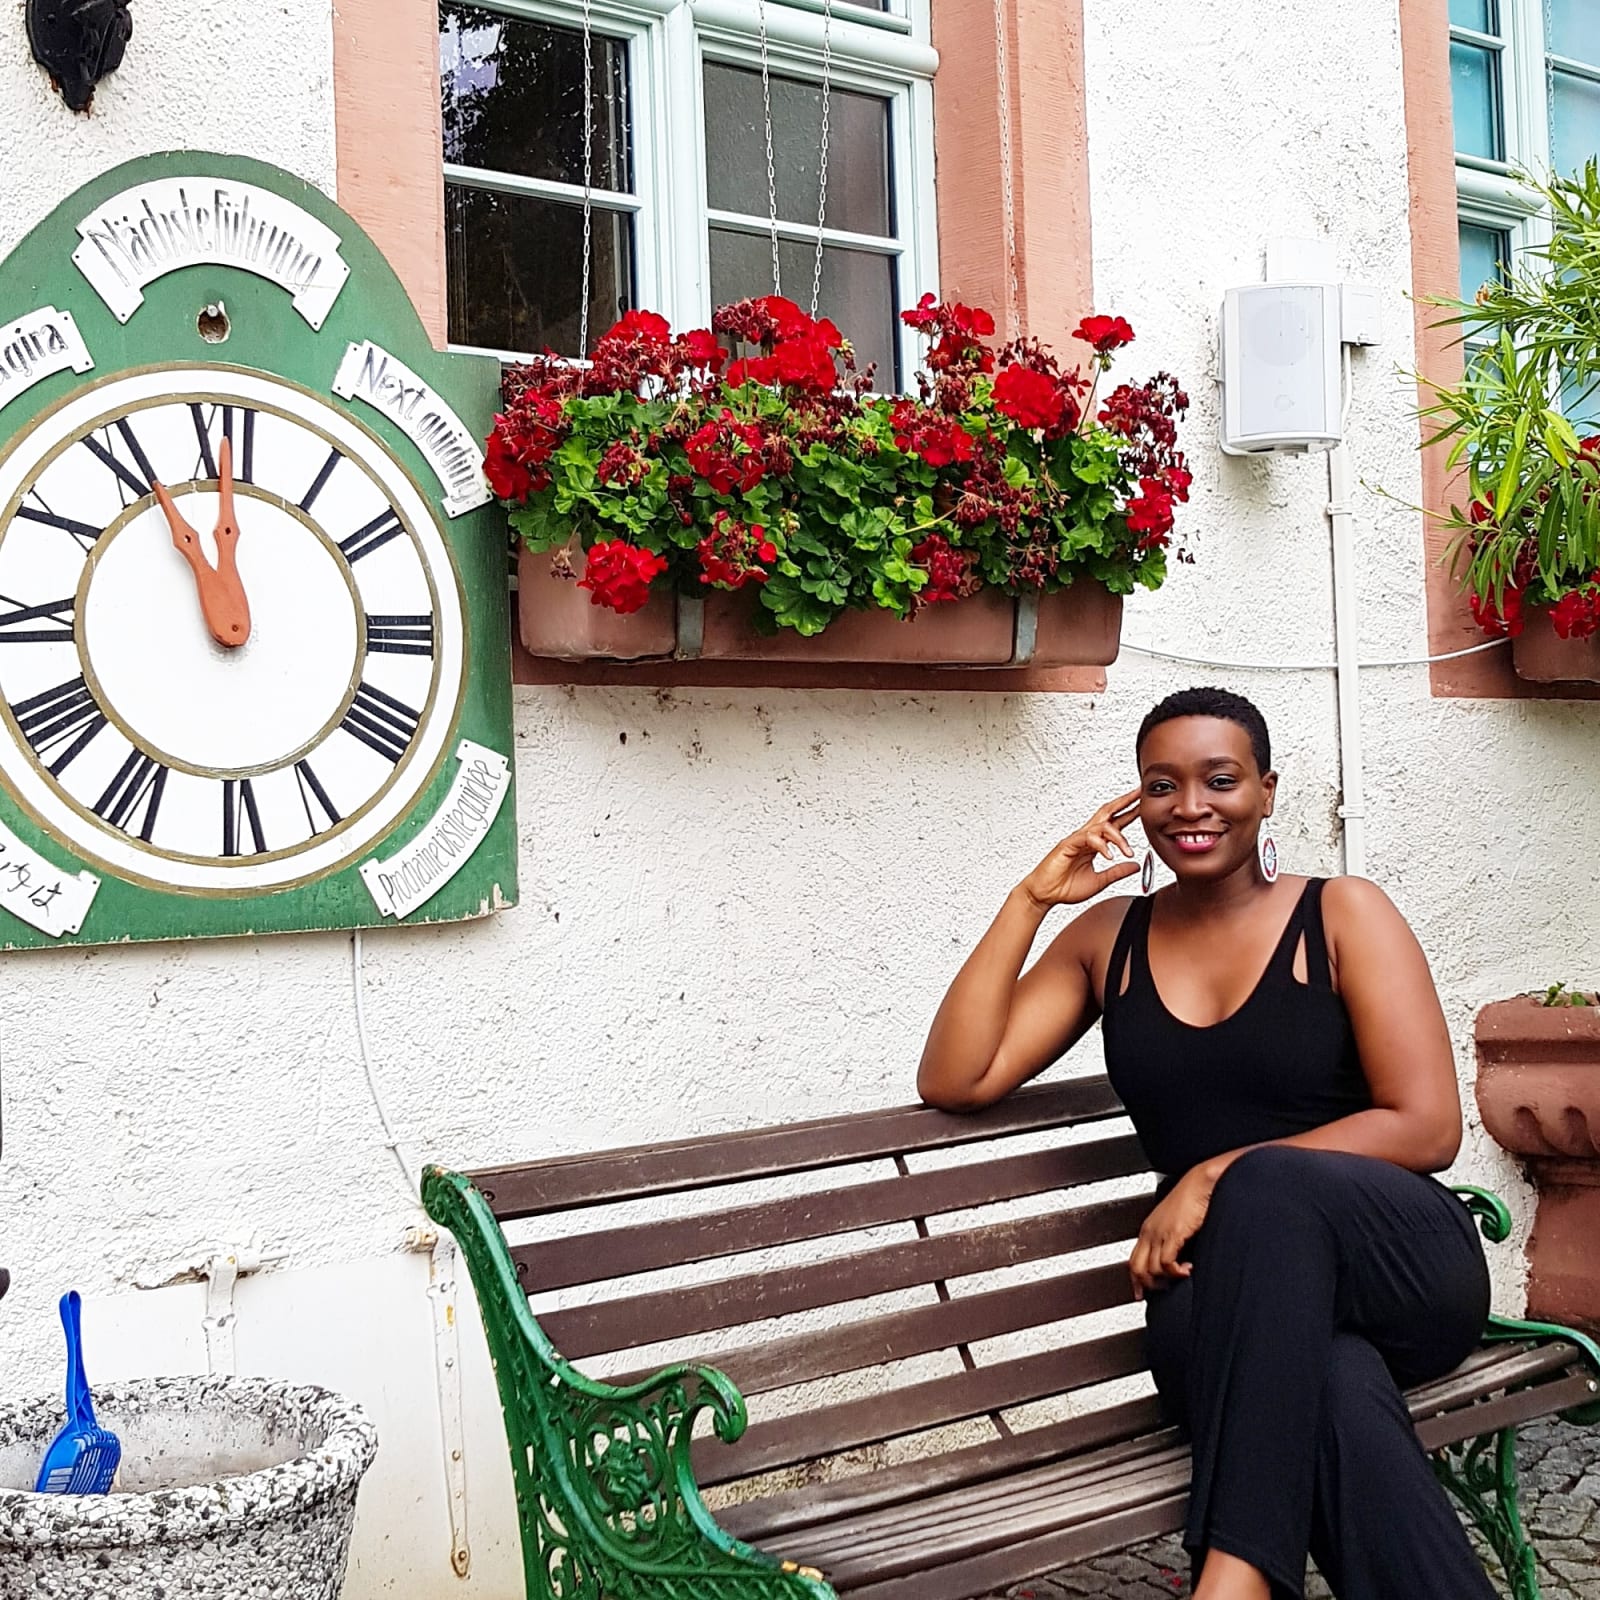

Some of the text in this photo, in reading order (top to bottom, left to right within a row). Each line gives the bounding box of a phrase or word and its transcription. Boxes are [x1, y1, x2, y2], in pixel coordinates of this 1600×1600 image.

[356, 346, 426, 421] Next
[78, 415, 168, 510] XI
[296, 446, 347, 515] I
[14, 483, 108, 557] X
[333, 504, 411, 569] II
[364, 610, 434, 661] III
[8, 672, 109, 781] VIII
[335, 679, 426, 769] IIII
[86, 744, 169, 844] VII
[218, 777, 270, 857] VI
[293, 758, 346, 839] V
[378, 758, 502, 910] Prochaine visite guidée
